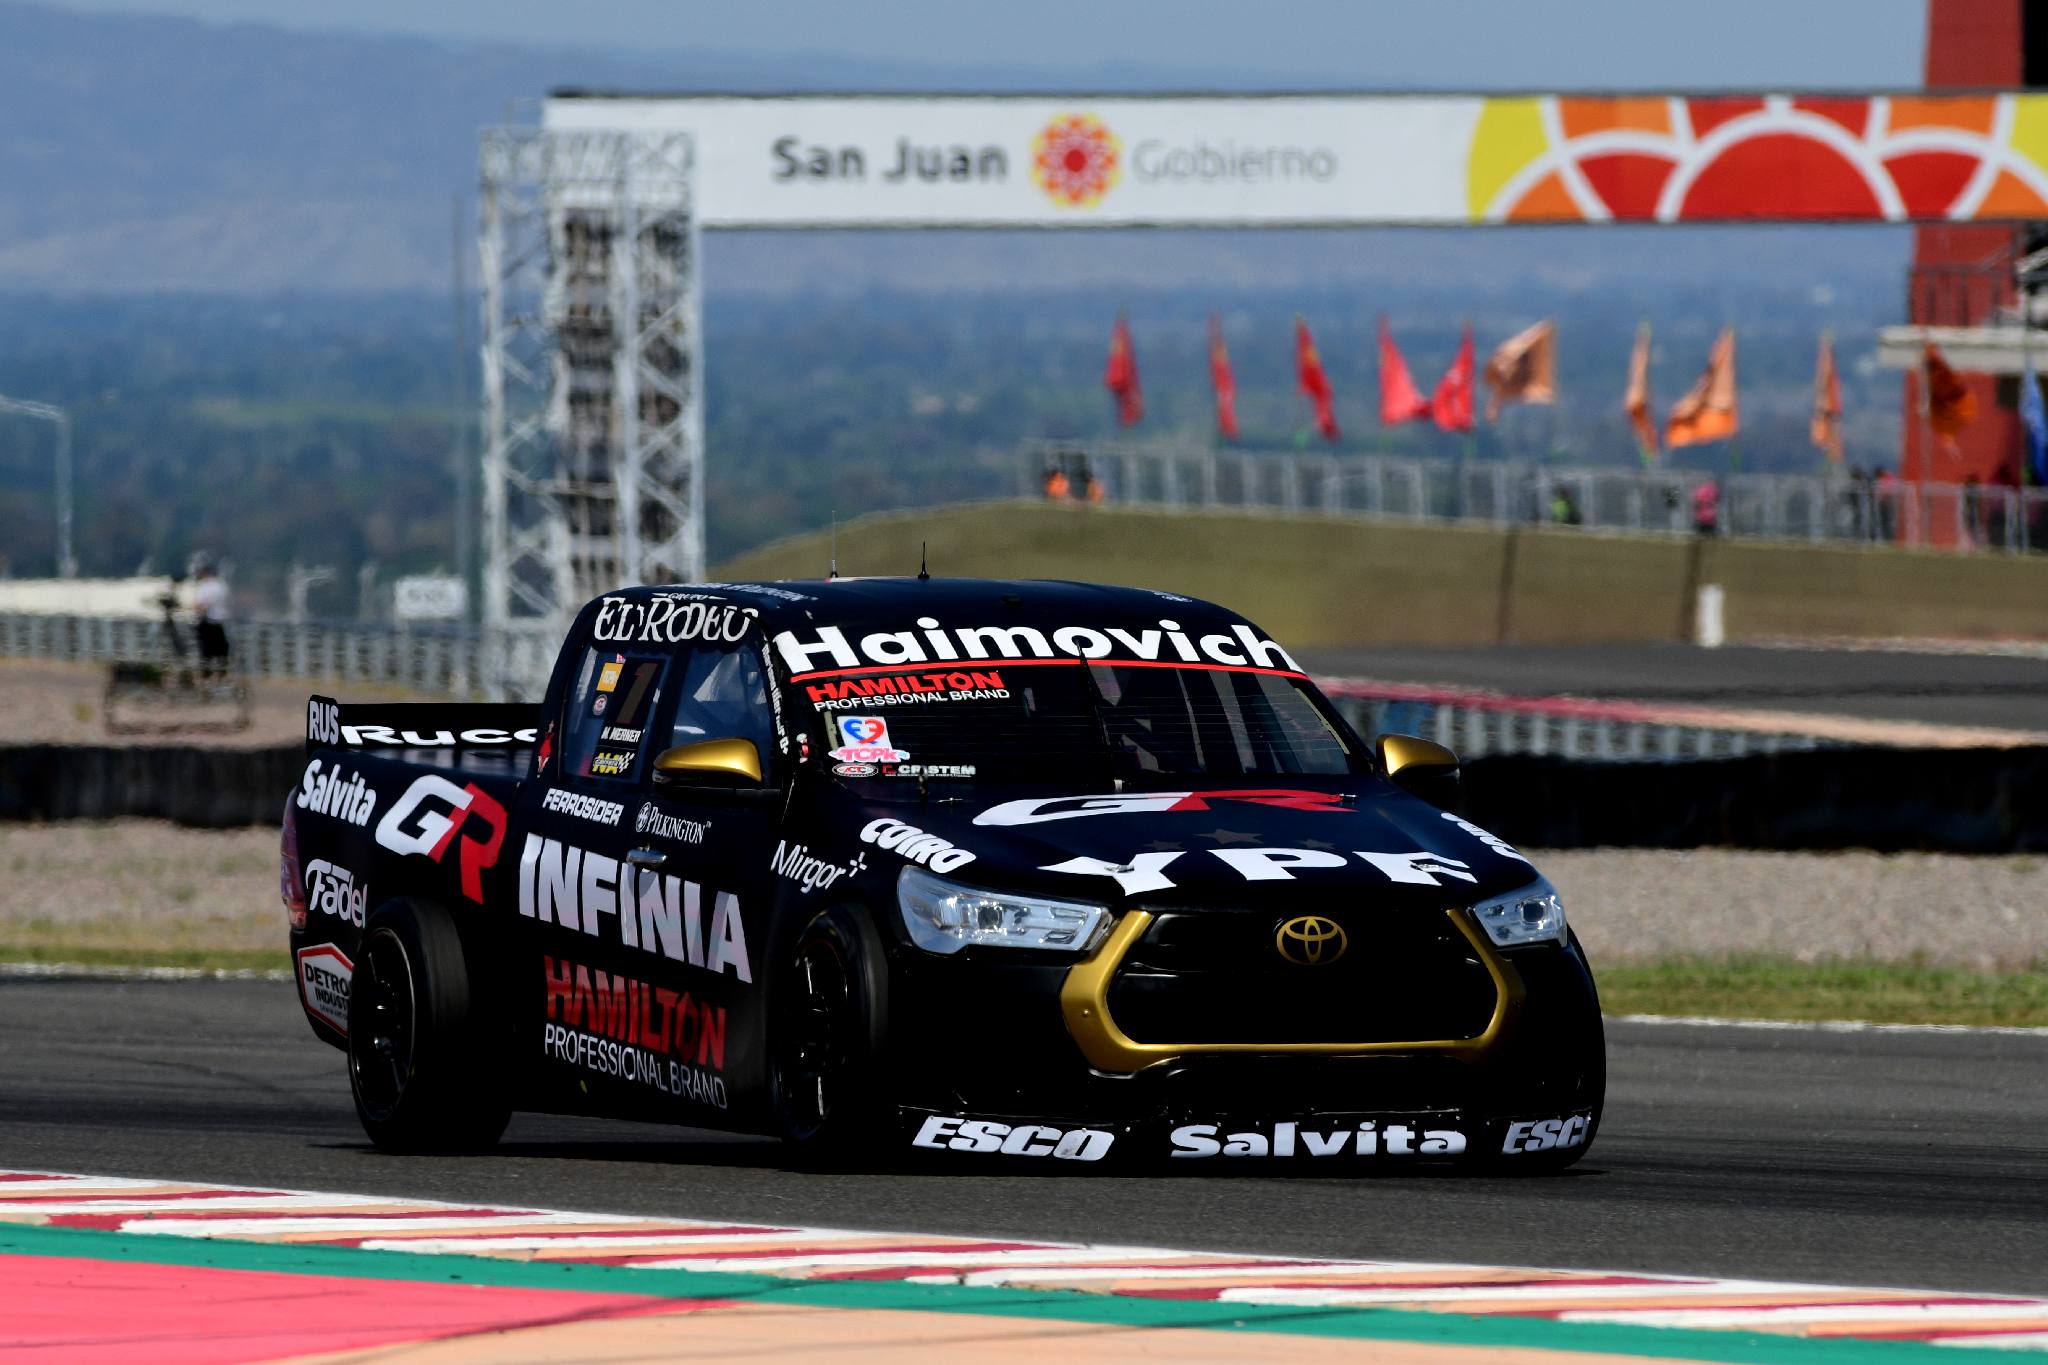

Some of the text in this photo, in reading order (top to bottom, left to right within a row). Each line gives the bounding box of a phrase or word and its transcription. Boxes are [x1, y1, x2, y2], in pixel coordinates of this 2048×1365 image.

[772, 137, 1337, 184] San Juan Gobierno
[773, 616, 1305, 675] Haimovich
[806, 671, 1005, 701] HAMILTON
[813, 688, 1010, 712] PROFESSIONAL BRAND
[309, 700, 339, 745] RUS
[297, 758, 377, 827] Salvita
[542, 787, 625, 827] FERROSIDER
[972, 789, 1359, 825] GR
[375, 774, 507, 905] GR
[860, 818, 977, 874] COIRO
[770, 839, 847, 894] Mirgor
[1037, 848, 1479, 896] YPF
[305, 858, 368, 929] Fadel
[519, 832, 753, 984] INFINIA
[544, 954, 727, 1072] HAMILTON
[544, 1022, 728, 1110] PROFESSIONAL BRAND
[912, 1116, 1115, 1161] ESCO
[1170, 1122, 1467, 1158] Salvita
